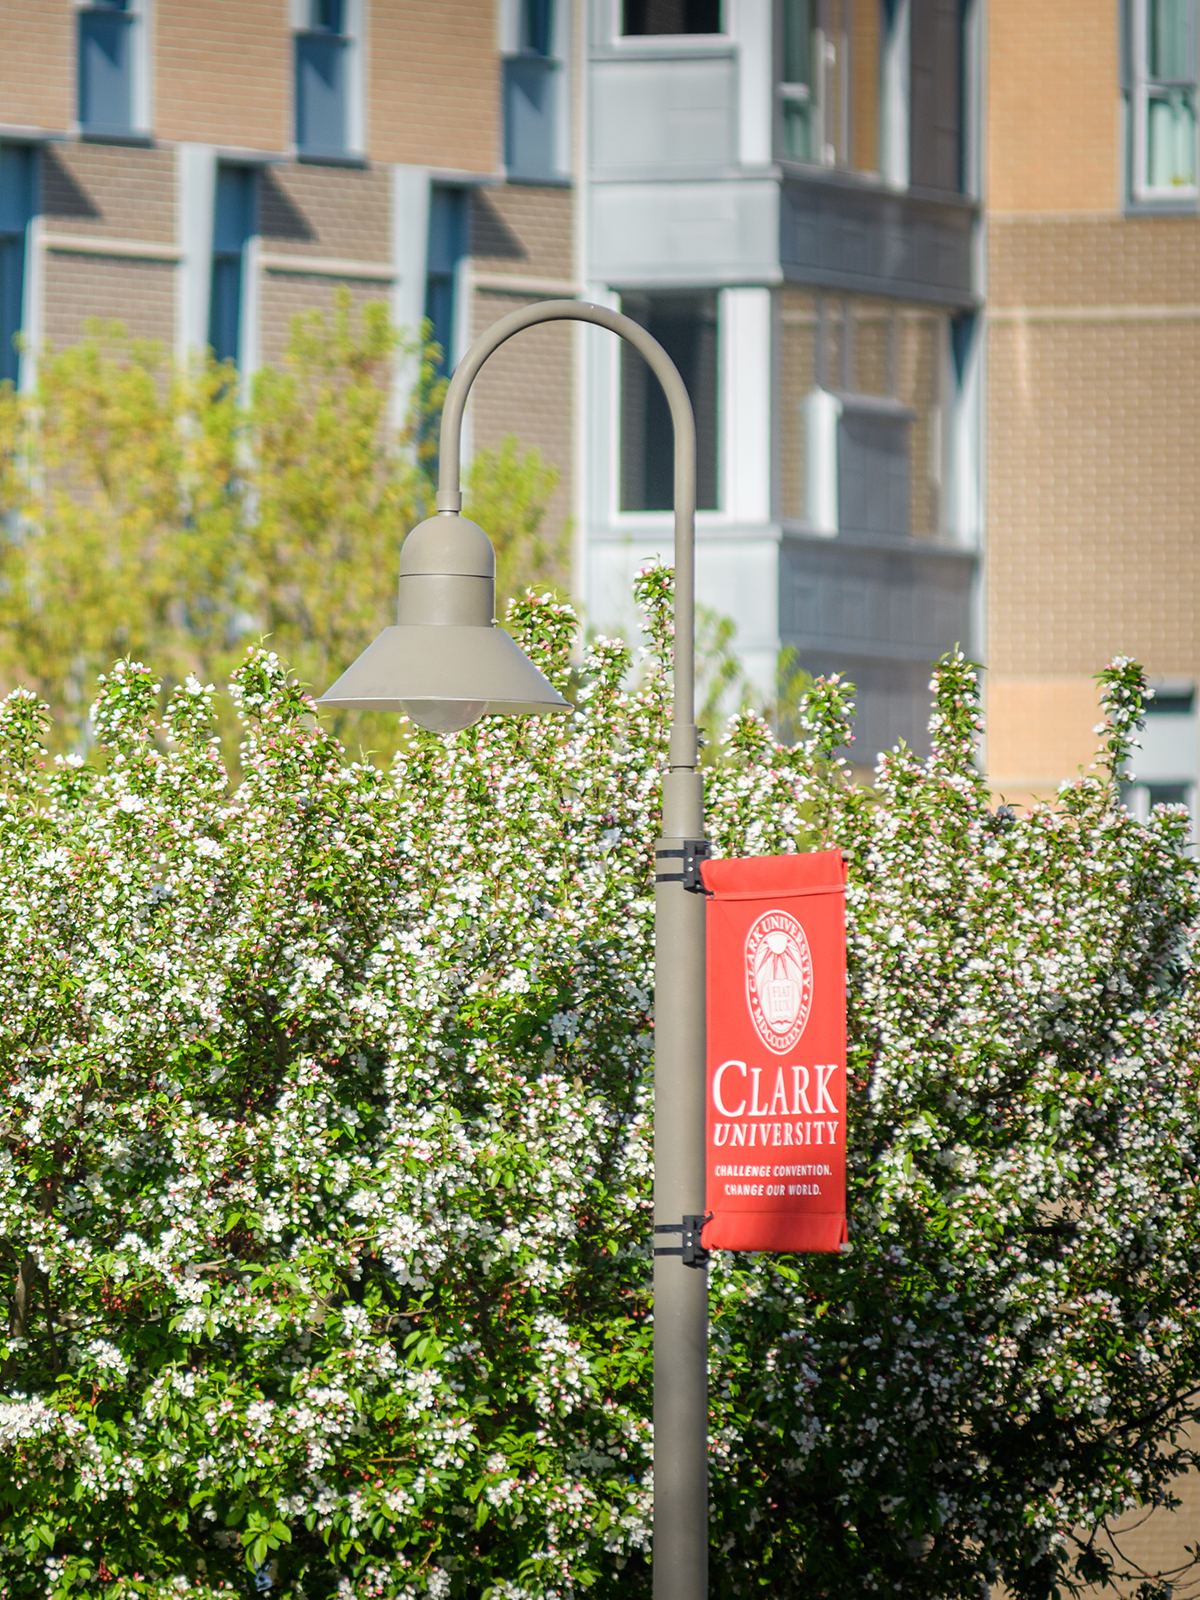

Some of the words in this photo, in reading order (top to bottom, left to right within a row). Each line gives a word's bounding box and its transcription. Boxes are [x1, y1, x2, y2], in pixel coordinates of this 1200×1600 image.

[747, 926, 764, 993] CLARK
[761, 915, 811, 989] UNIVERSITY
[773, 986, 791, 998] FIAT
[774, 1000, 790, 1012] LUX
[713, 1060, 839, 1117] CLARK
[714, 1121, 839, 1146] UNIVERSITY
[715, 1165, 771, 1177] CHALLENGE
[773, 1164, 832, 1177] CONVENTION.
[725, 1184, 764, 1196] CHANGE
[766, 1184, 786, 1196] OUR
[788, 1184, 822, 1196] WORLD.
